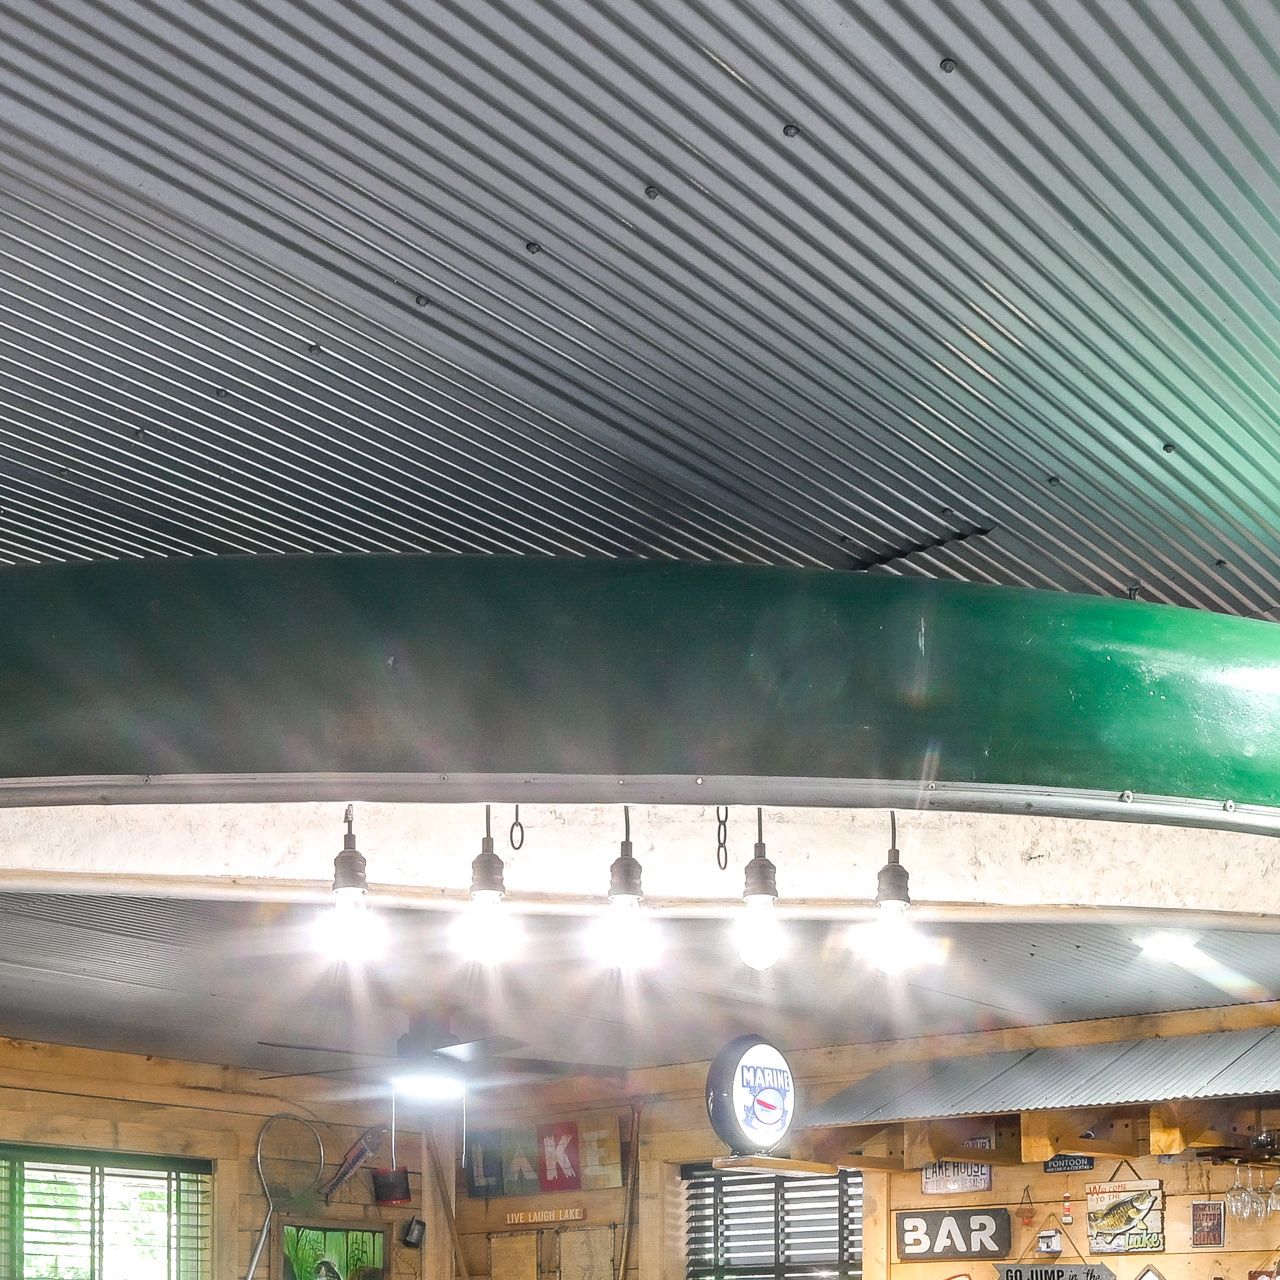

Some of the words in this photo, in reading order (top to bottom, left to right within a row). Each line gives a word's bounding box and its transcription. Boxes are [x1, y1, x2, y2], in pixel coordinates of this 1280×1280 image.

[742, 1065, 790, 1092] MARINE
[925, 1160, 950, 1180] LAKE
[952, 1161, 987, 1178] HOUSE
[1048, 1158, 1088, 1168] PONTOON
[507, 1212, 524, 1224] LIVE
[528, 1210, 555, 1222] LAUGH
[559, 1208, 582, 1220] LAKE
[904, 1215, 999, 1254] BAR
[1124, 1231, 1160, 1251] Lake
[1068, 1270, 1079, 1280] in
